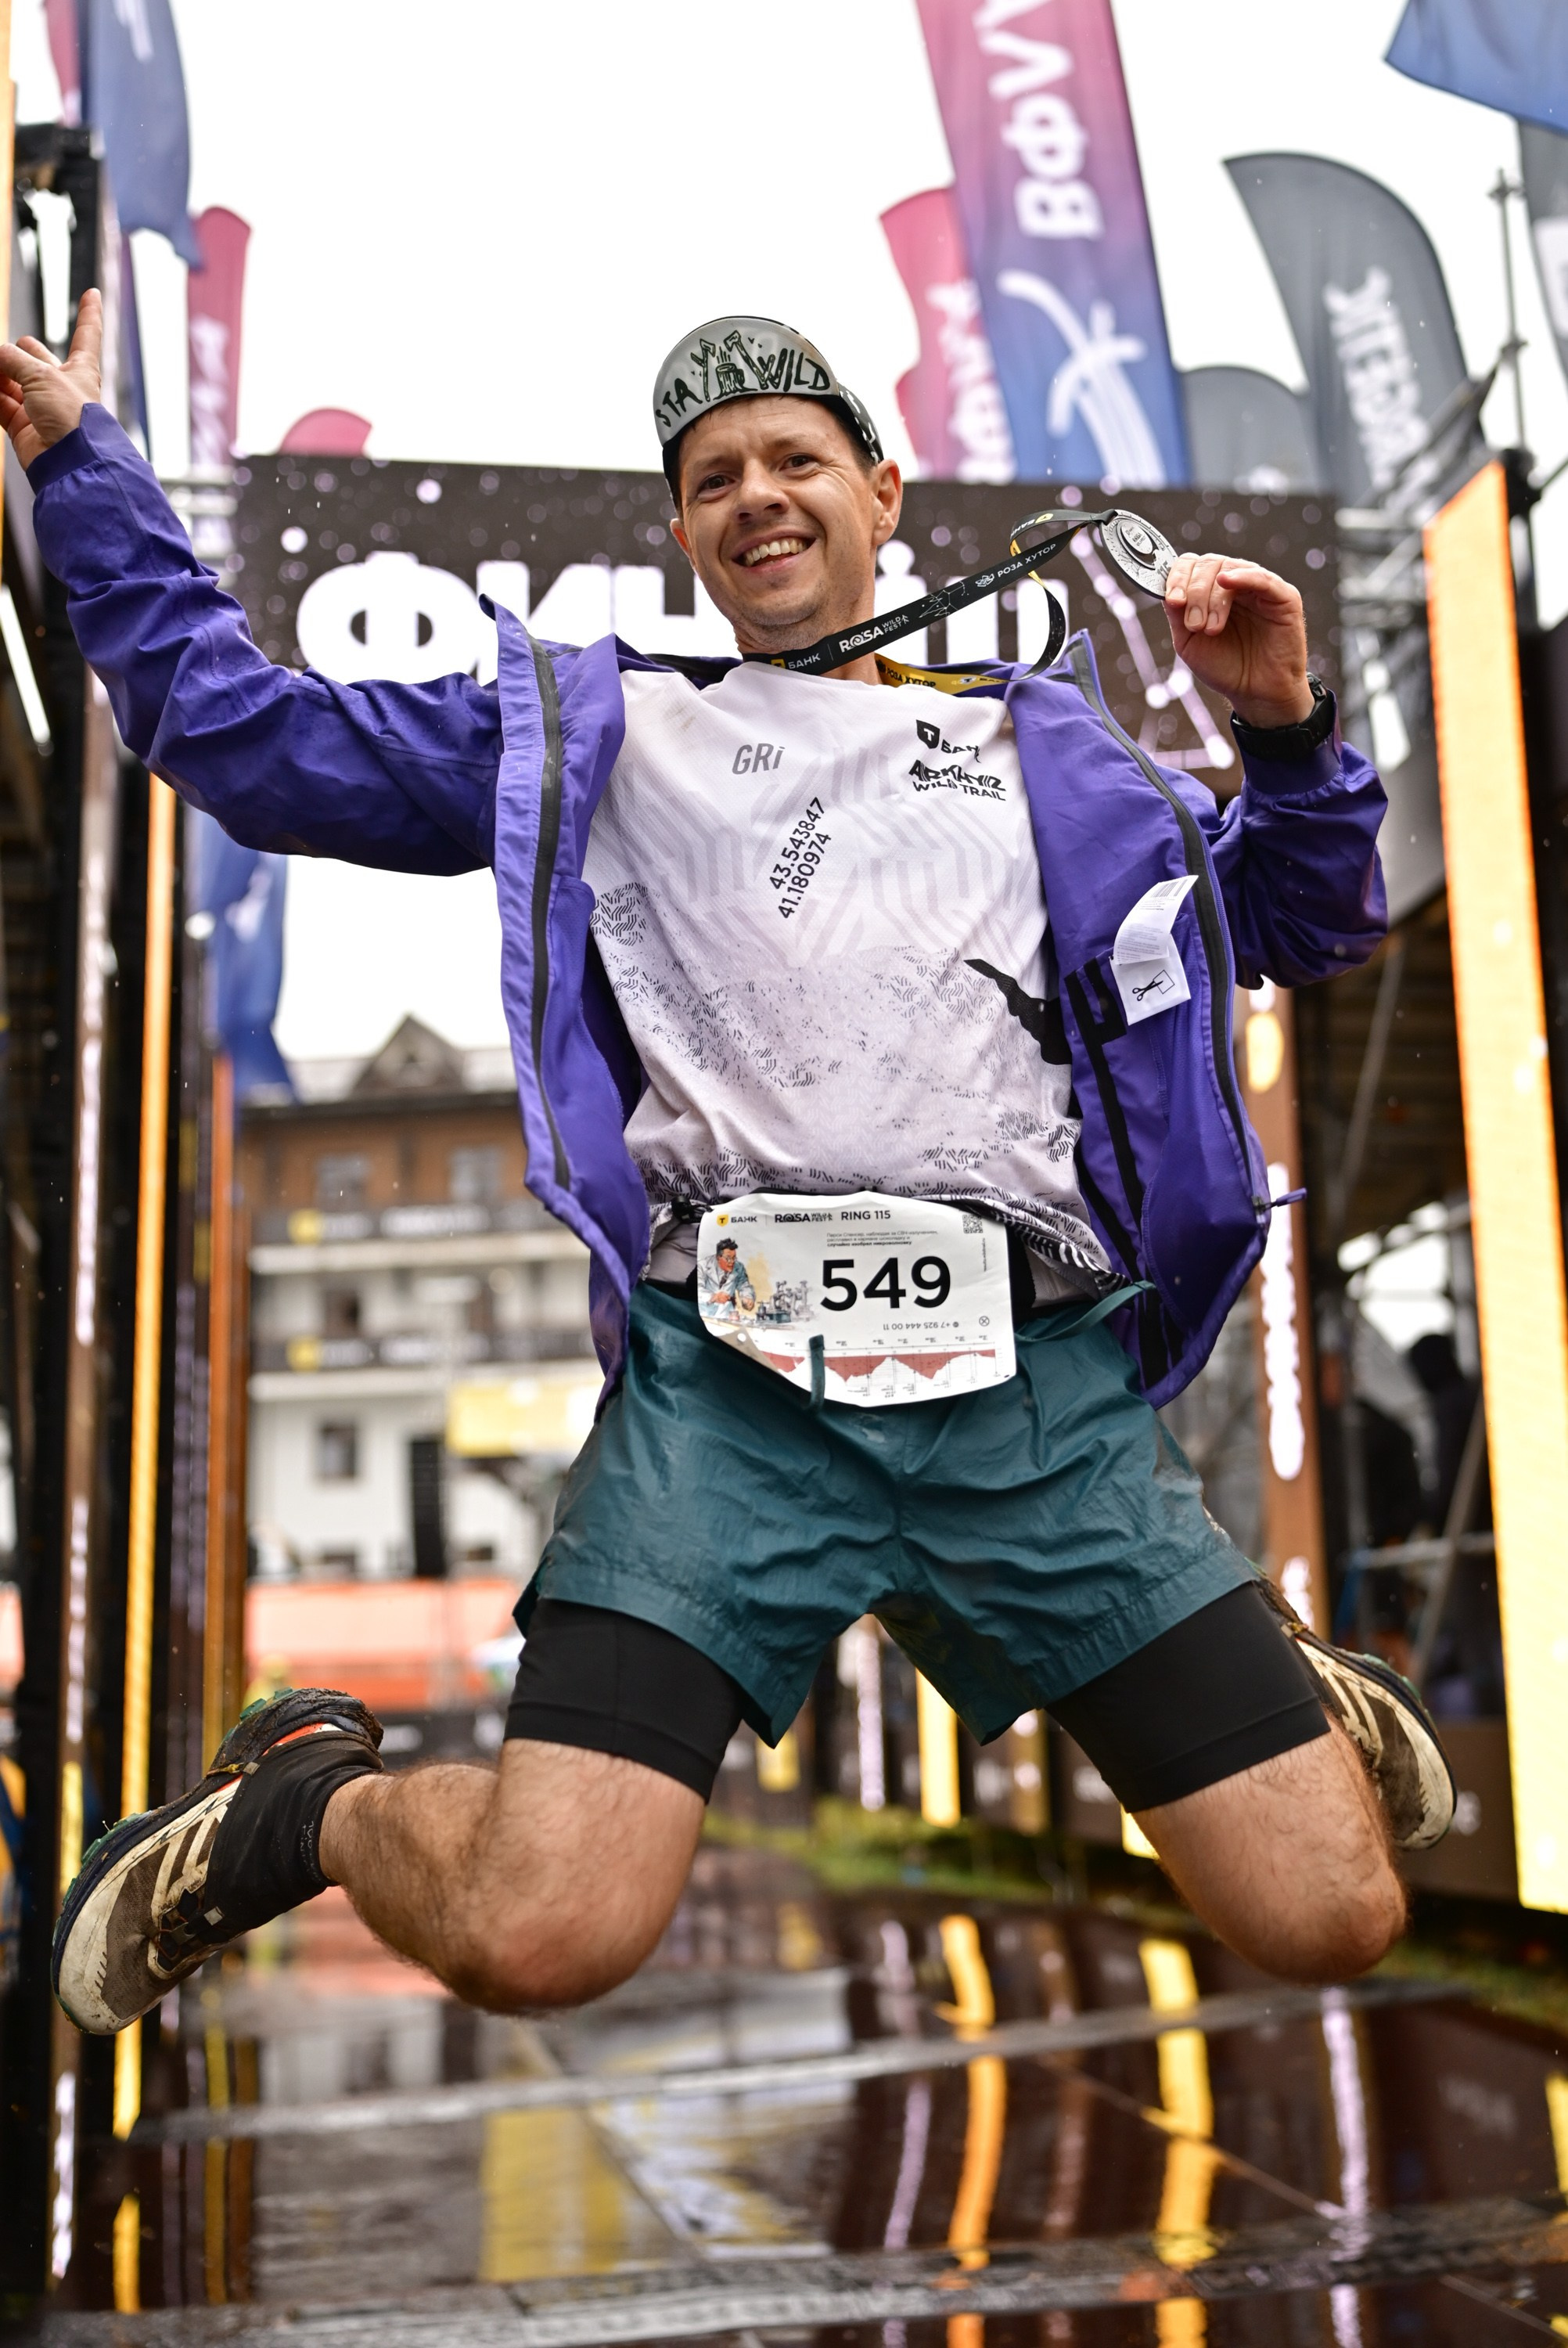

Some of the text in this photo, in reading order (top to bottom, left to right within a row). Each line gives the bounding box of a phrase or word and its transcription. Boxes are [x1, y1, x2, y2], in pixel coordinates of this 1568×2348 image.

[656, 337, 830, 427] STAY WILD
[998, 543, 1056, 578] РОЗА ХУТОР
[882, 617, 901, 628] WILD
[884, 621, 902, 633] FEST
[839, 626, 884, 653] ROSA
[788, 653, 821, 670] БАНК
[913, 778, 1006, 801] WILD TRAIL
[769, 796, 825, 890] 43.543847
[778, 832, 832, 919] 41.180974
[731, 1215, 757, 1223] БАНК
[775, 1213, 811, 1223] ROSA
[841, 1209, 891, 1221] RING 115
[820, 1255, 951, 1311] 549
